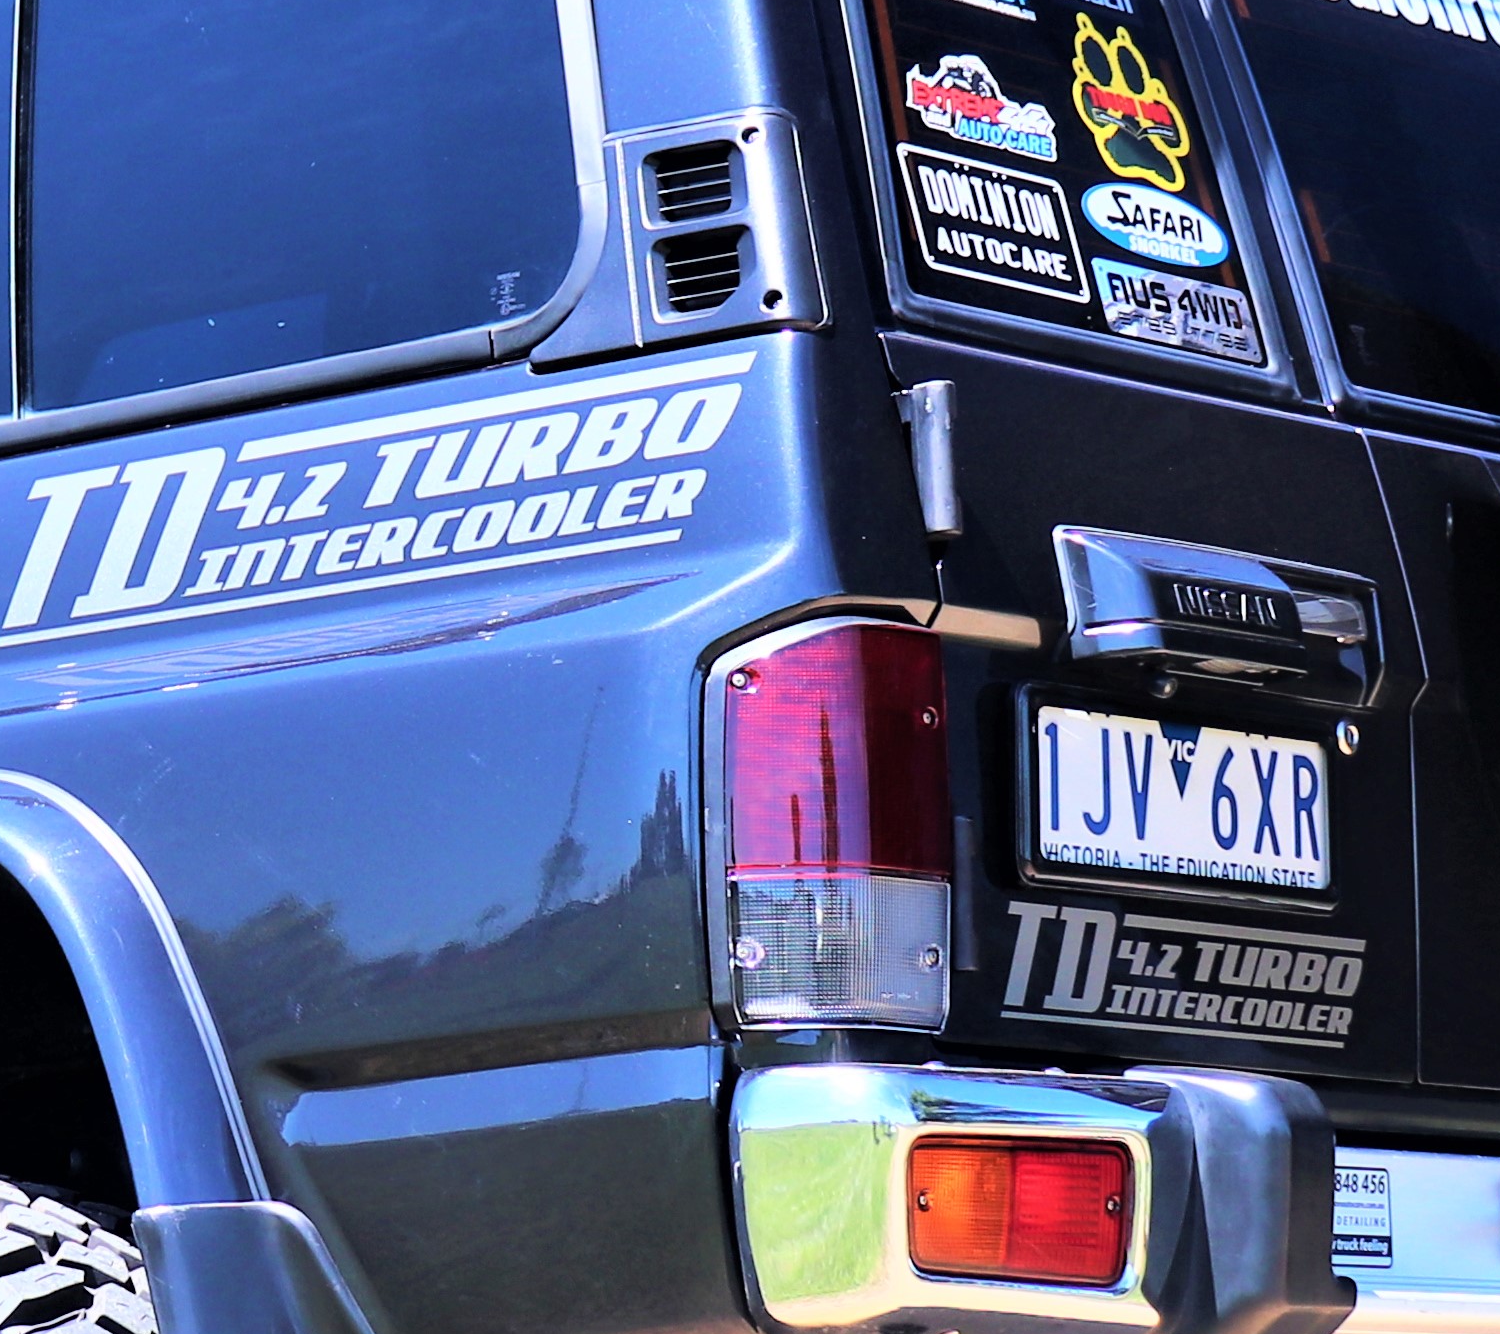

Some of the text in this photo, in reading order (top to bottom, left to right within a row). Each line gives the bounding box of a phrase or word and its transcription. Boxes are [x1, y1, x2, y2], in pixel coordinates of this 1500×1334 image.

[958, 116, 1003, 147] AUTO
[1004, 131, 1054, 158] CARE
[917, 165, 1061, 241] DOMINION
[1106, 191, 1204, 244] SAFARI
[937, 226, 1073, 281] AUTOCARE
[1128, 235, 1200, 266] SNORKEL
[1106, 273, 1244, 331] AUS 4WD
[1, 382, 744, 630] TD 4.2 TURBO
[181, 467, 707, 598] INTERCOOLER
[1173, 582, 1278, 630] NISSAN
[1166, 737, 1196, 764] VIC
[1044, 722, 1321, 862] 1JV 6XR
[1043, 841, 1123, 870] VICTORIA
[1139, 852, 1171, 874] THE
[1002, 900, 1364, 1013] TD 4.2 TURBO
[1106, 982, 1354, 1036] INTERCOOLER
[1361, 1173, 1386, 1195] 456
[1336, 1215, 1387, 1228] DETAILING
[1337, 1237, 1359, 1252] truck
[1359, 1237, 1389, 1255] feeling
